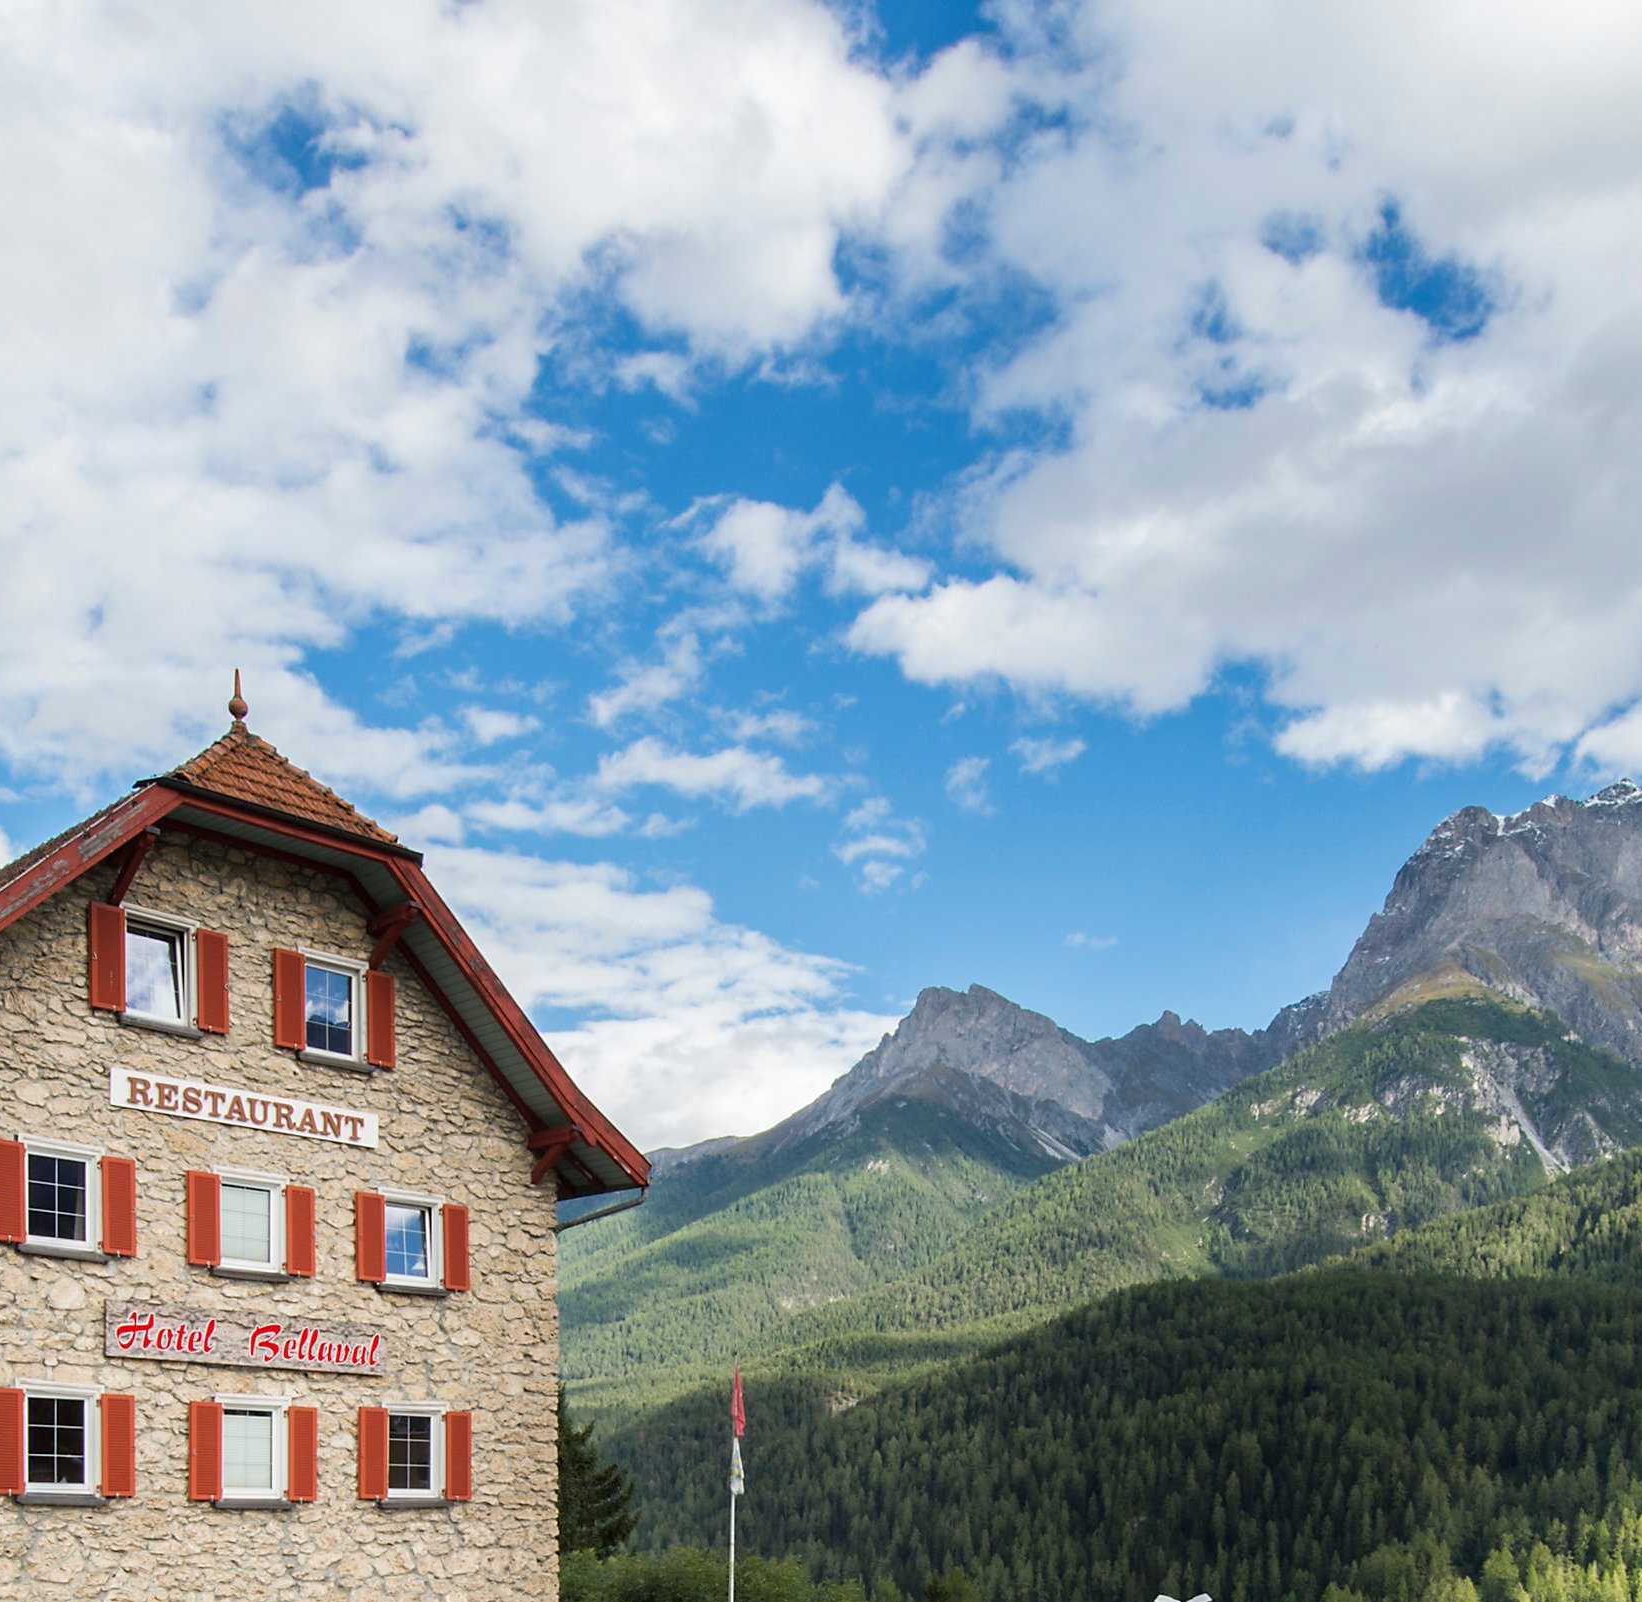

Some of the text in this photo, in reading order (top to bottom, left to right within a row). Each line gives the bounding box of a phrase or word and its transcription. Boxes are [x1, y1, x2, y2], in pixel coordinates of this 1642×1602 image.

[127, 1076, 365, 1141] RESTAURANT
[115, 1311, 382, 1367] Hotel Bellaval
